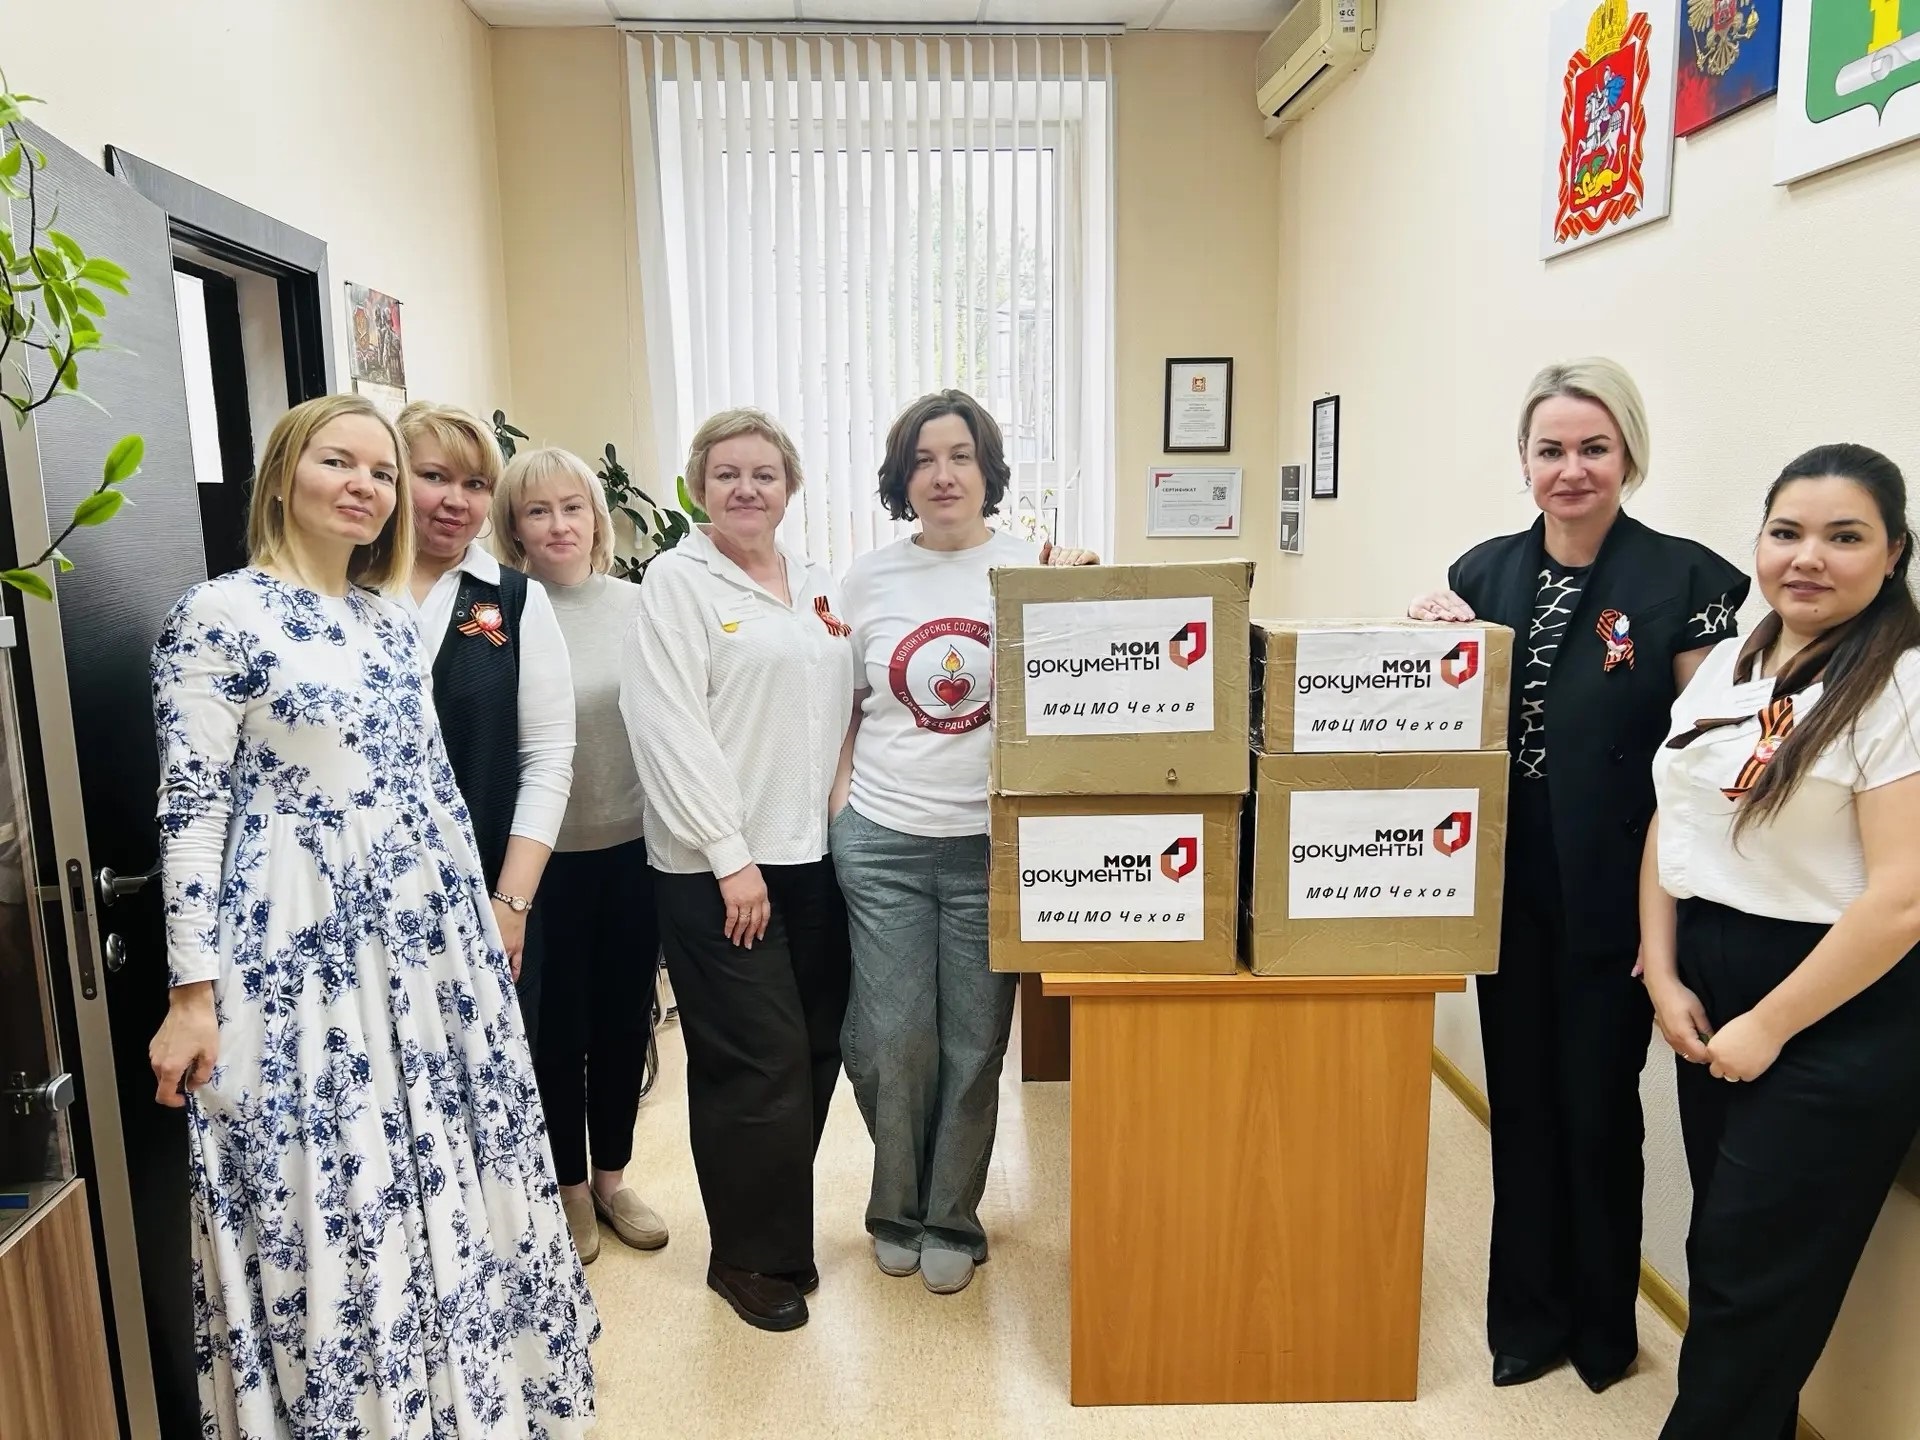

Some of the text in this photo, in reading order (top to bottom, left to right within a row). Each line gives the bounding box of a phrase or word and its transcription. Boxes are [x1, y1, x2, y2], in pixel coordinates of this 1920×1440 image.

[896, 622, 992, 662] ВОЛОНТЕРСКОЕ СОДРУЖ
[1027, 655, 1160, 679] документы
[1297, 673, 1431, 695] документы
[1043, 701, 1195, 717] МФЦ МО Чехов
[1311, 718, 1464, 733] МФЦ МО Чехов
[1291, 842, 1424, 864] документы
[1021, 868, 1152, 888] документы
[1306, 885, 1456, 901] МФЦ МО Чехов
[1037, 910, 1186, 925] МФЦ МО Чехов
